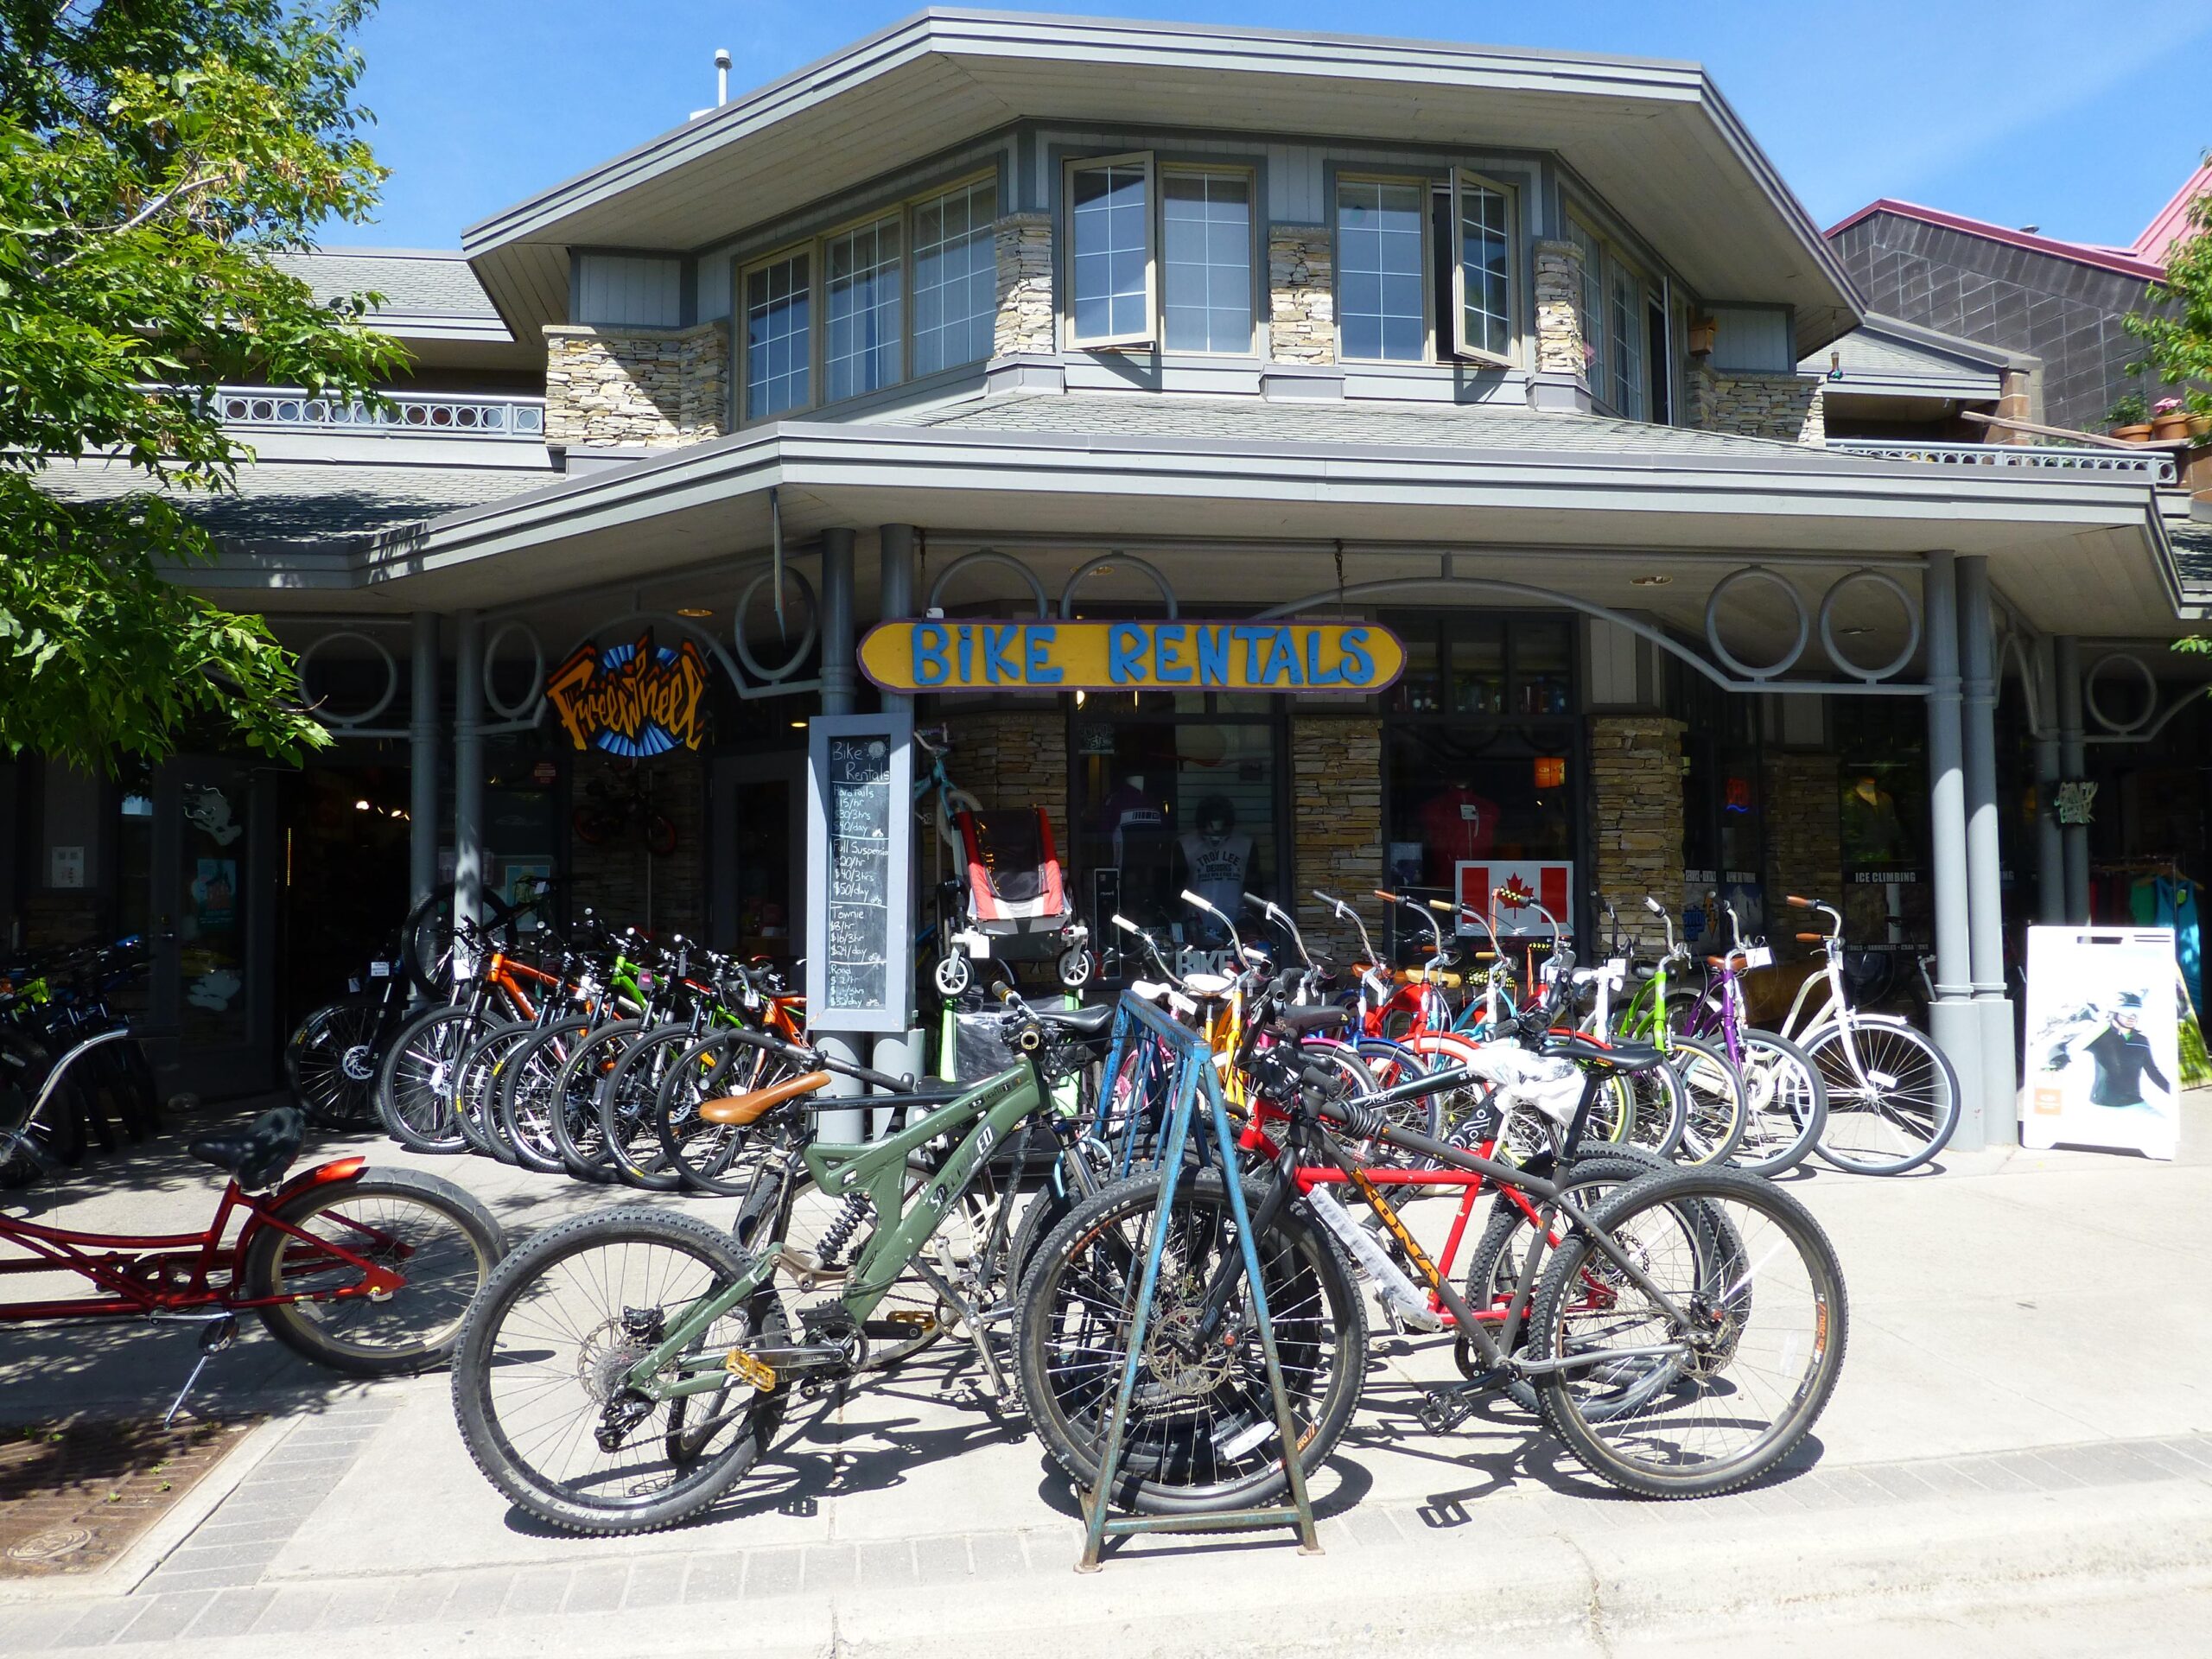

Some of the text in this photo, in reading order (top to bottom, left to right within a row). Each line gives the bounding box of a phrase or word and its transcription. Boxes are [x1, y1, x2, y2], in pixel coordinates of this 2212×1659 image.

[1109, 623, 1375, 685] RENTALS
[833, 741, 863, 760] Bike
[845, 761, 890, 782] Rentals
[833, 838, 849, 854] Full
[1196, 850, 1240, 867] TROY LEE
[1855, 873, 1916, 882] ICE CLIMBING
[833, 881, 869, 903] $50/day
[831, 906, 864, 918] Townie
[831, 920, 855, 933] $8/hr
[831, 932, 864, 944] $16/3hr
[831, 944, 868, 963] $24/day
[831, 963, 851, 975] Road
[1061, 1199, 1131, 1255] MAXXIS
[1351, 1166, 1440, 1288] KONA
